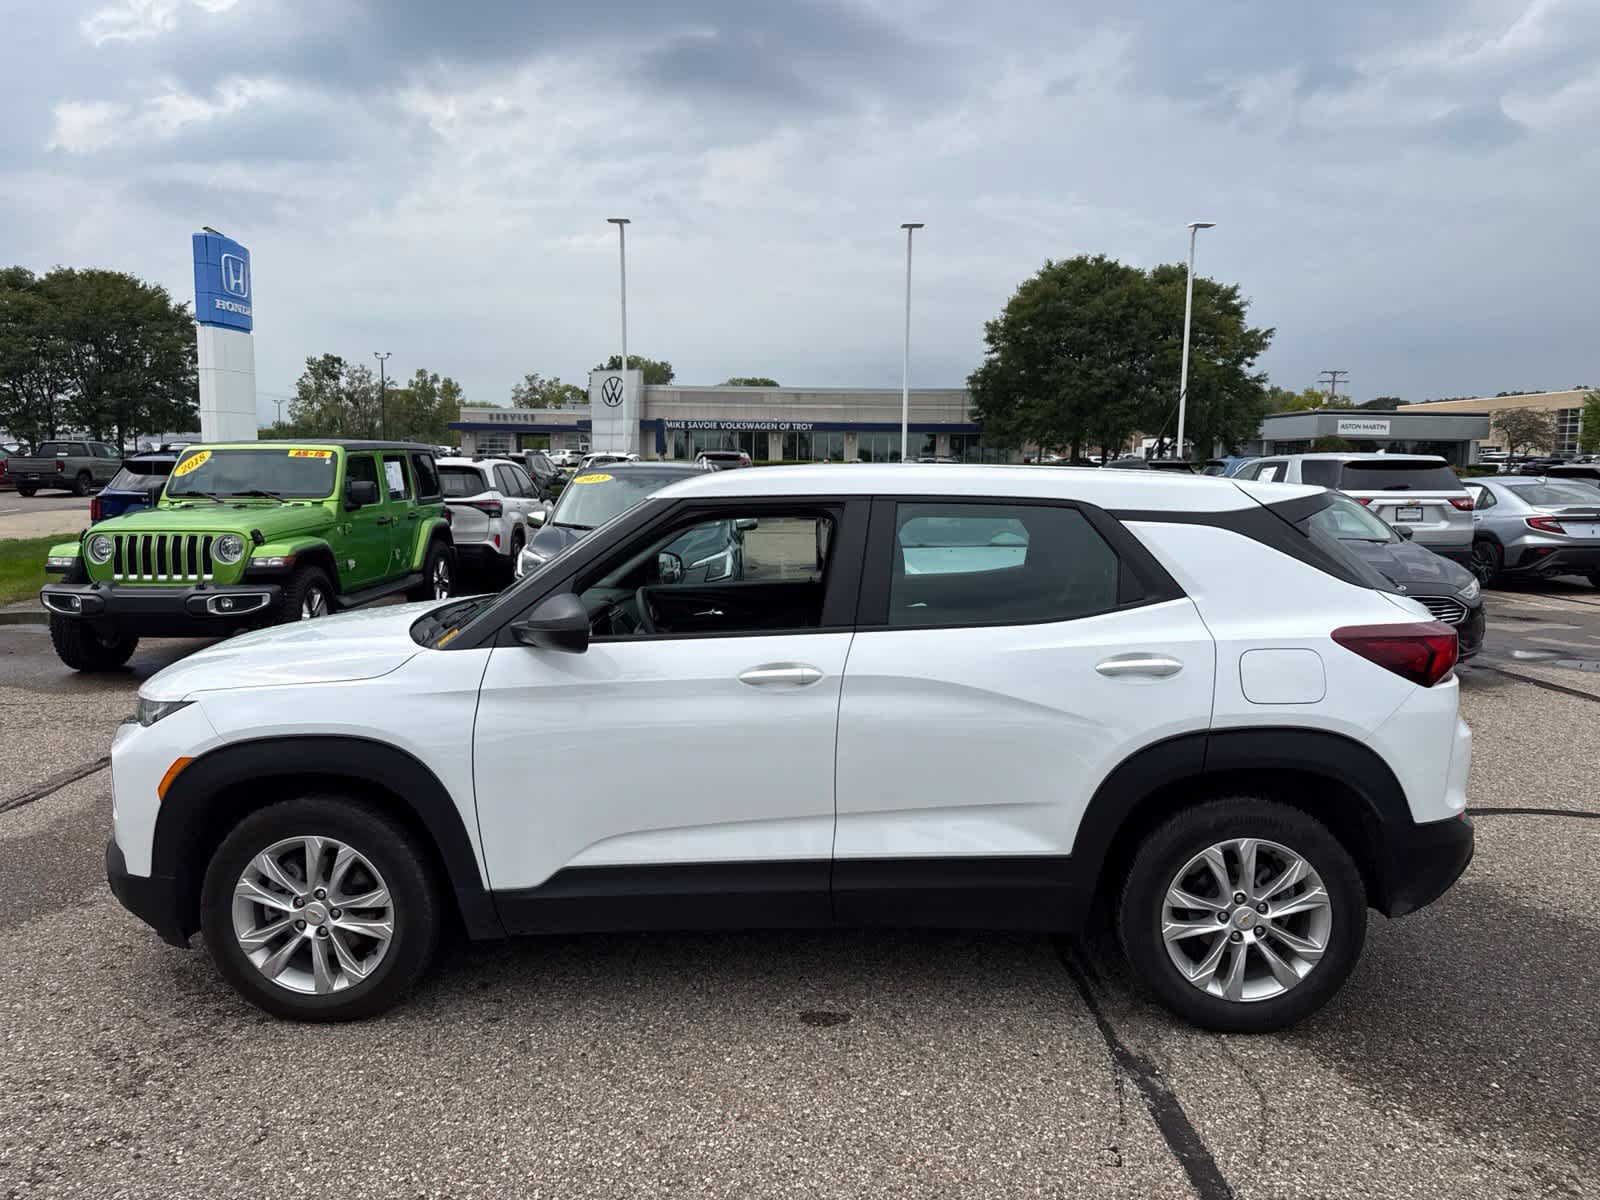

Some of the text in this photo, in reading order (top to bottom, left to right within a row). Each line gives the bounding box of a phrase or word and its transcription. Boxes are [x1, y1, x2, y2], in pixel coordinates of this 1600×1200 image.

[488, 413, 535, 422] SERVICE
[666, 421, 685, 429] MIKE
[687, 421, 717, 430] SAVOIE
[720, 422, 777, 430] VOLKSWAGEN
[793, 423, 813, 431] TROY
[180, 453, 206, 474] 2018
